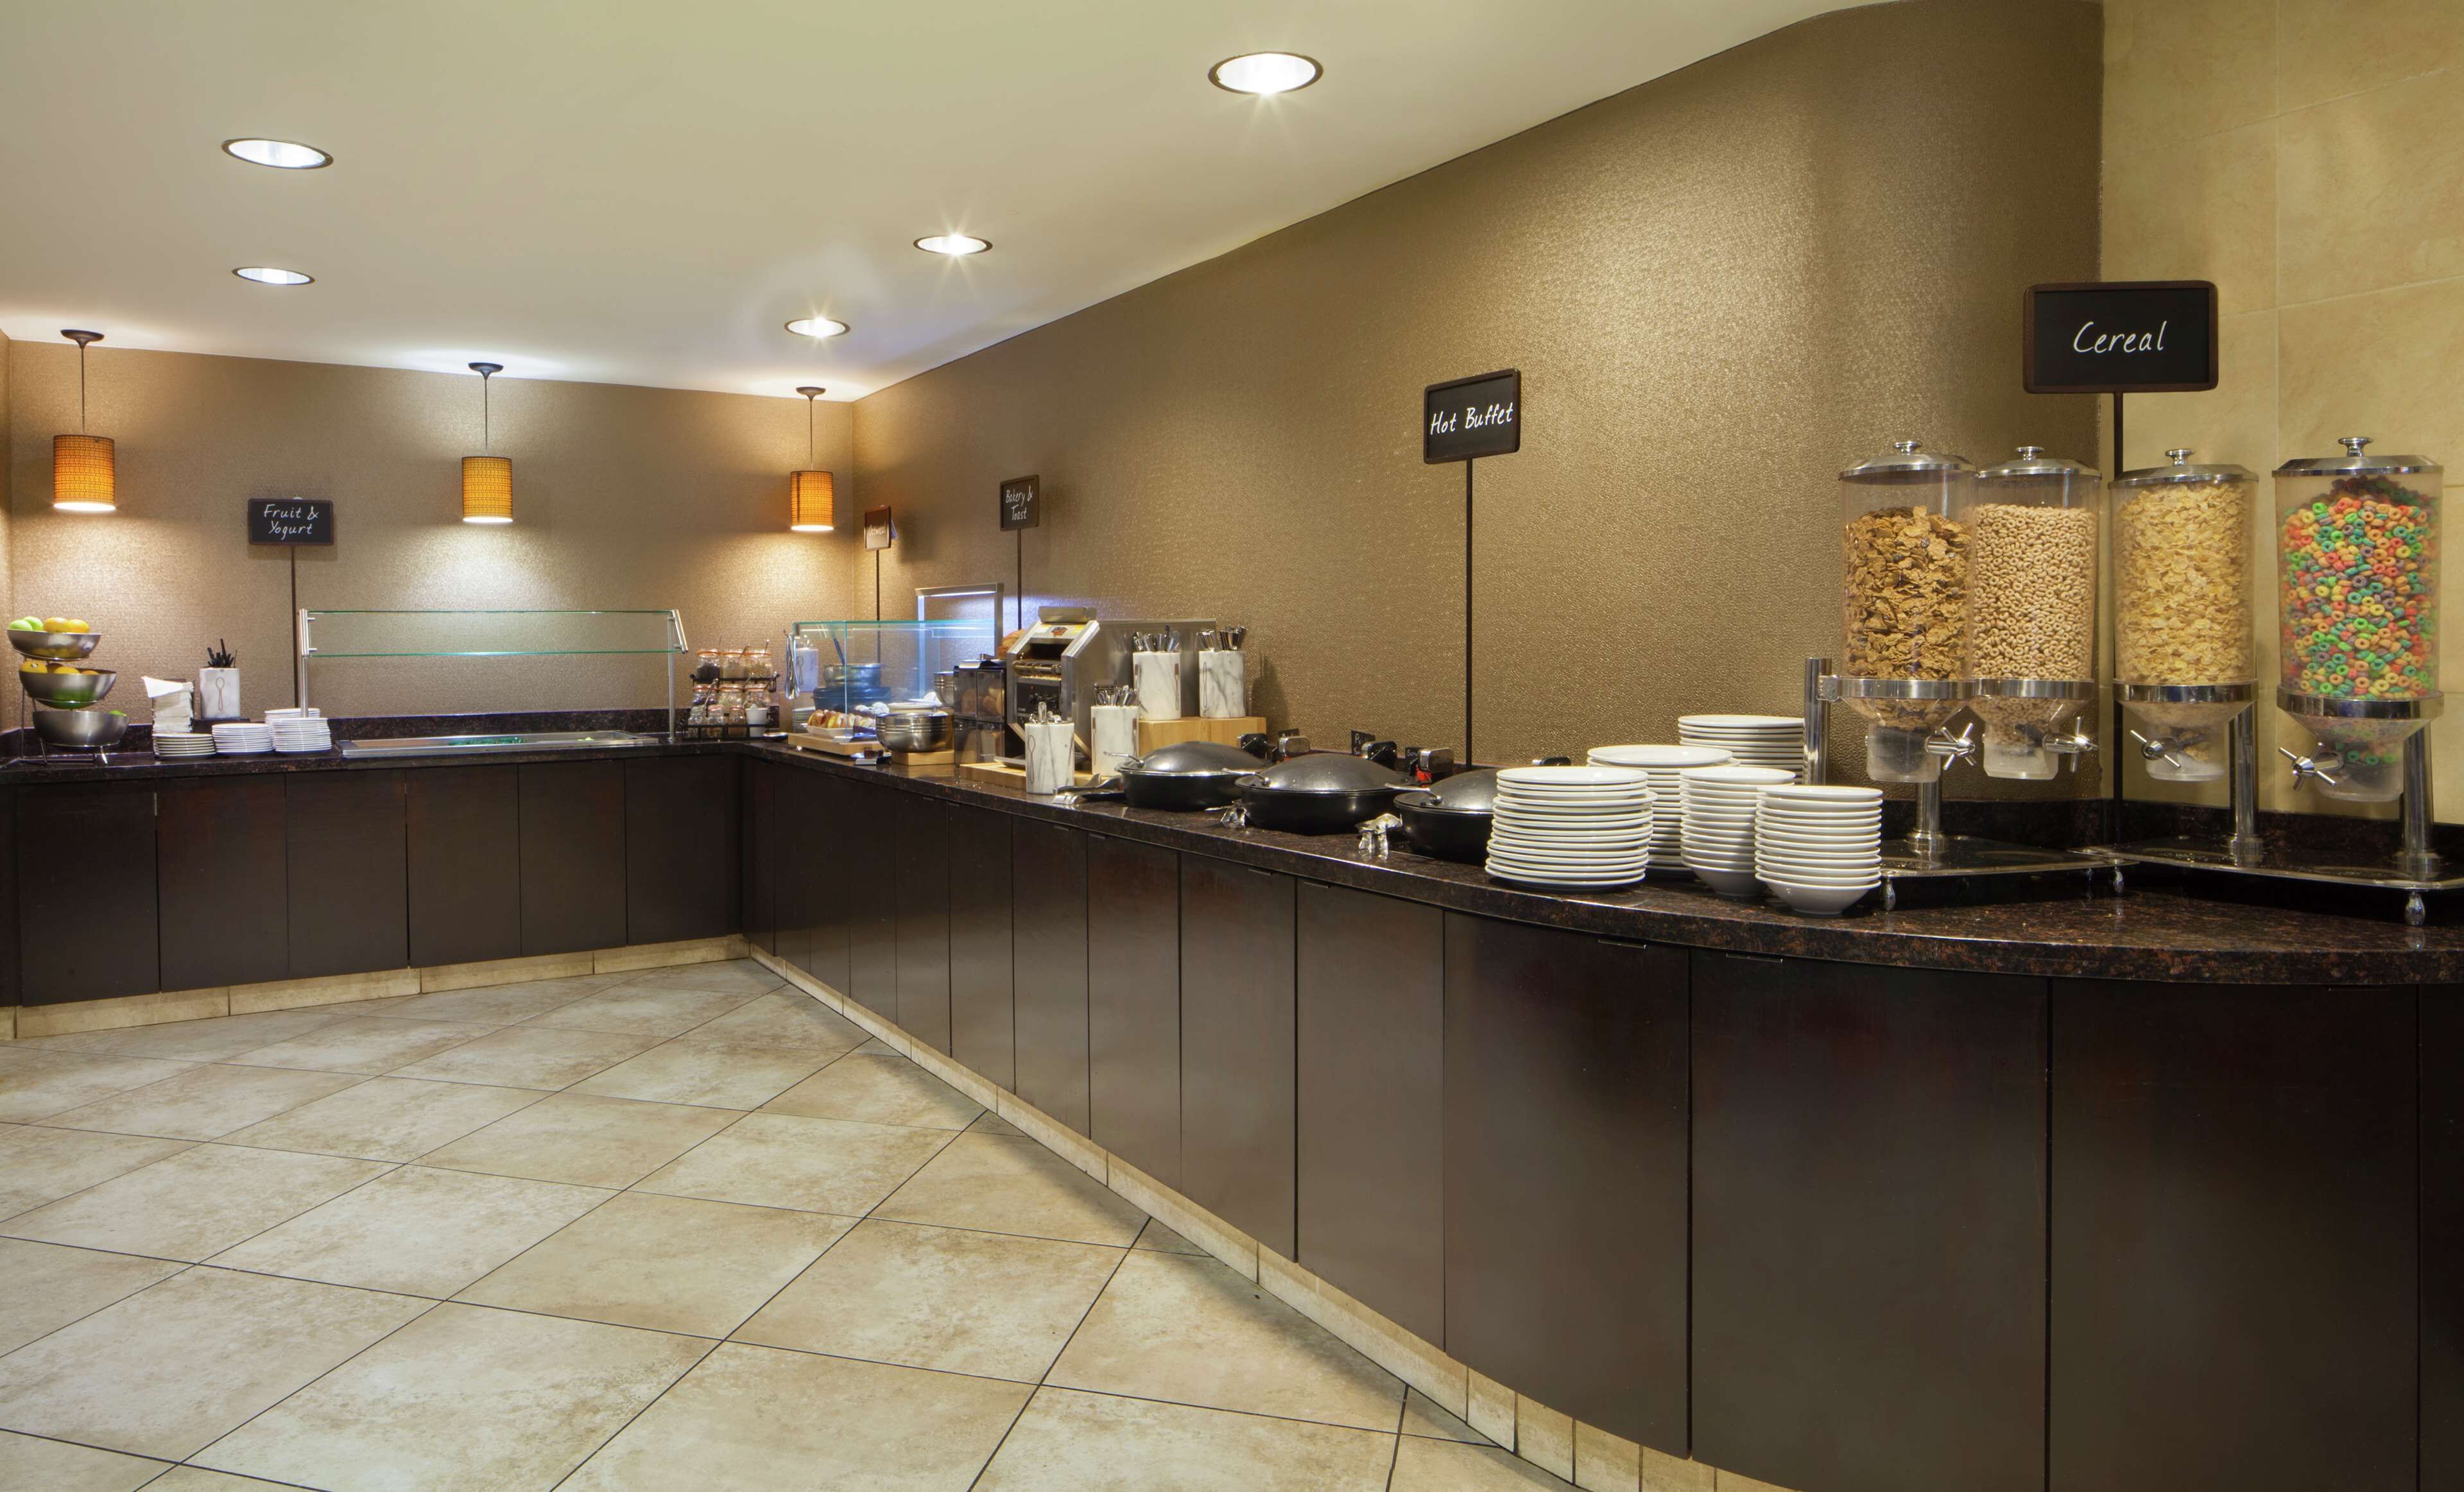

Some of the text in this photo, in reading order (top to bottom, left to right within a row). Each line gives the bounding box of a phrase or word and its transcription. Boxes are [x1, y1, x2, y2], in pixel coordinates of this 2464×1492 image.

[2073, 320, 2167, 354] Cereal
[1430, 402, 1513, 435] Hot Buffet
[1006, 484, 1033, 508] Bakery &
[263, 504, 319, 520] Fruit &
[1011, 504, 1027, 521] Toast
[268, 520, 313, 540] Yogurt
